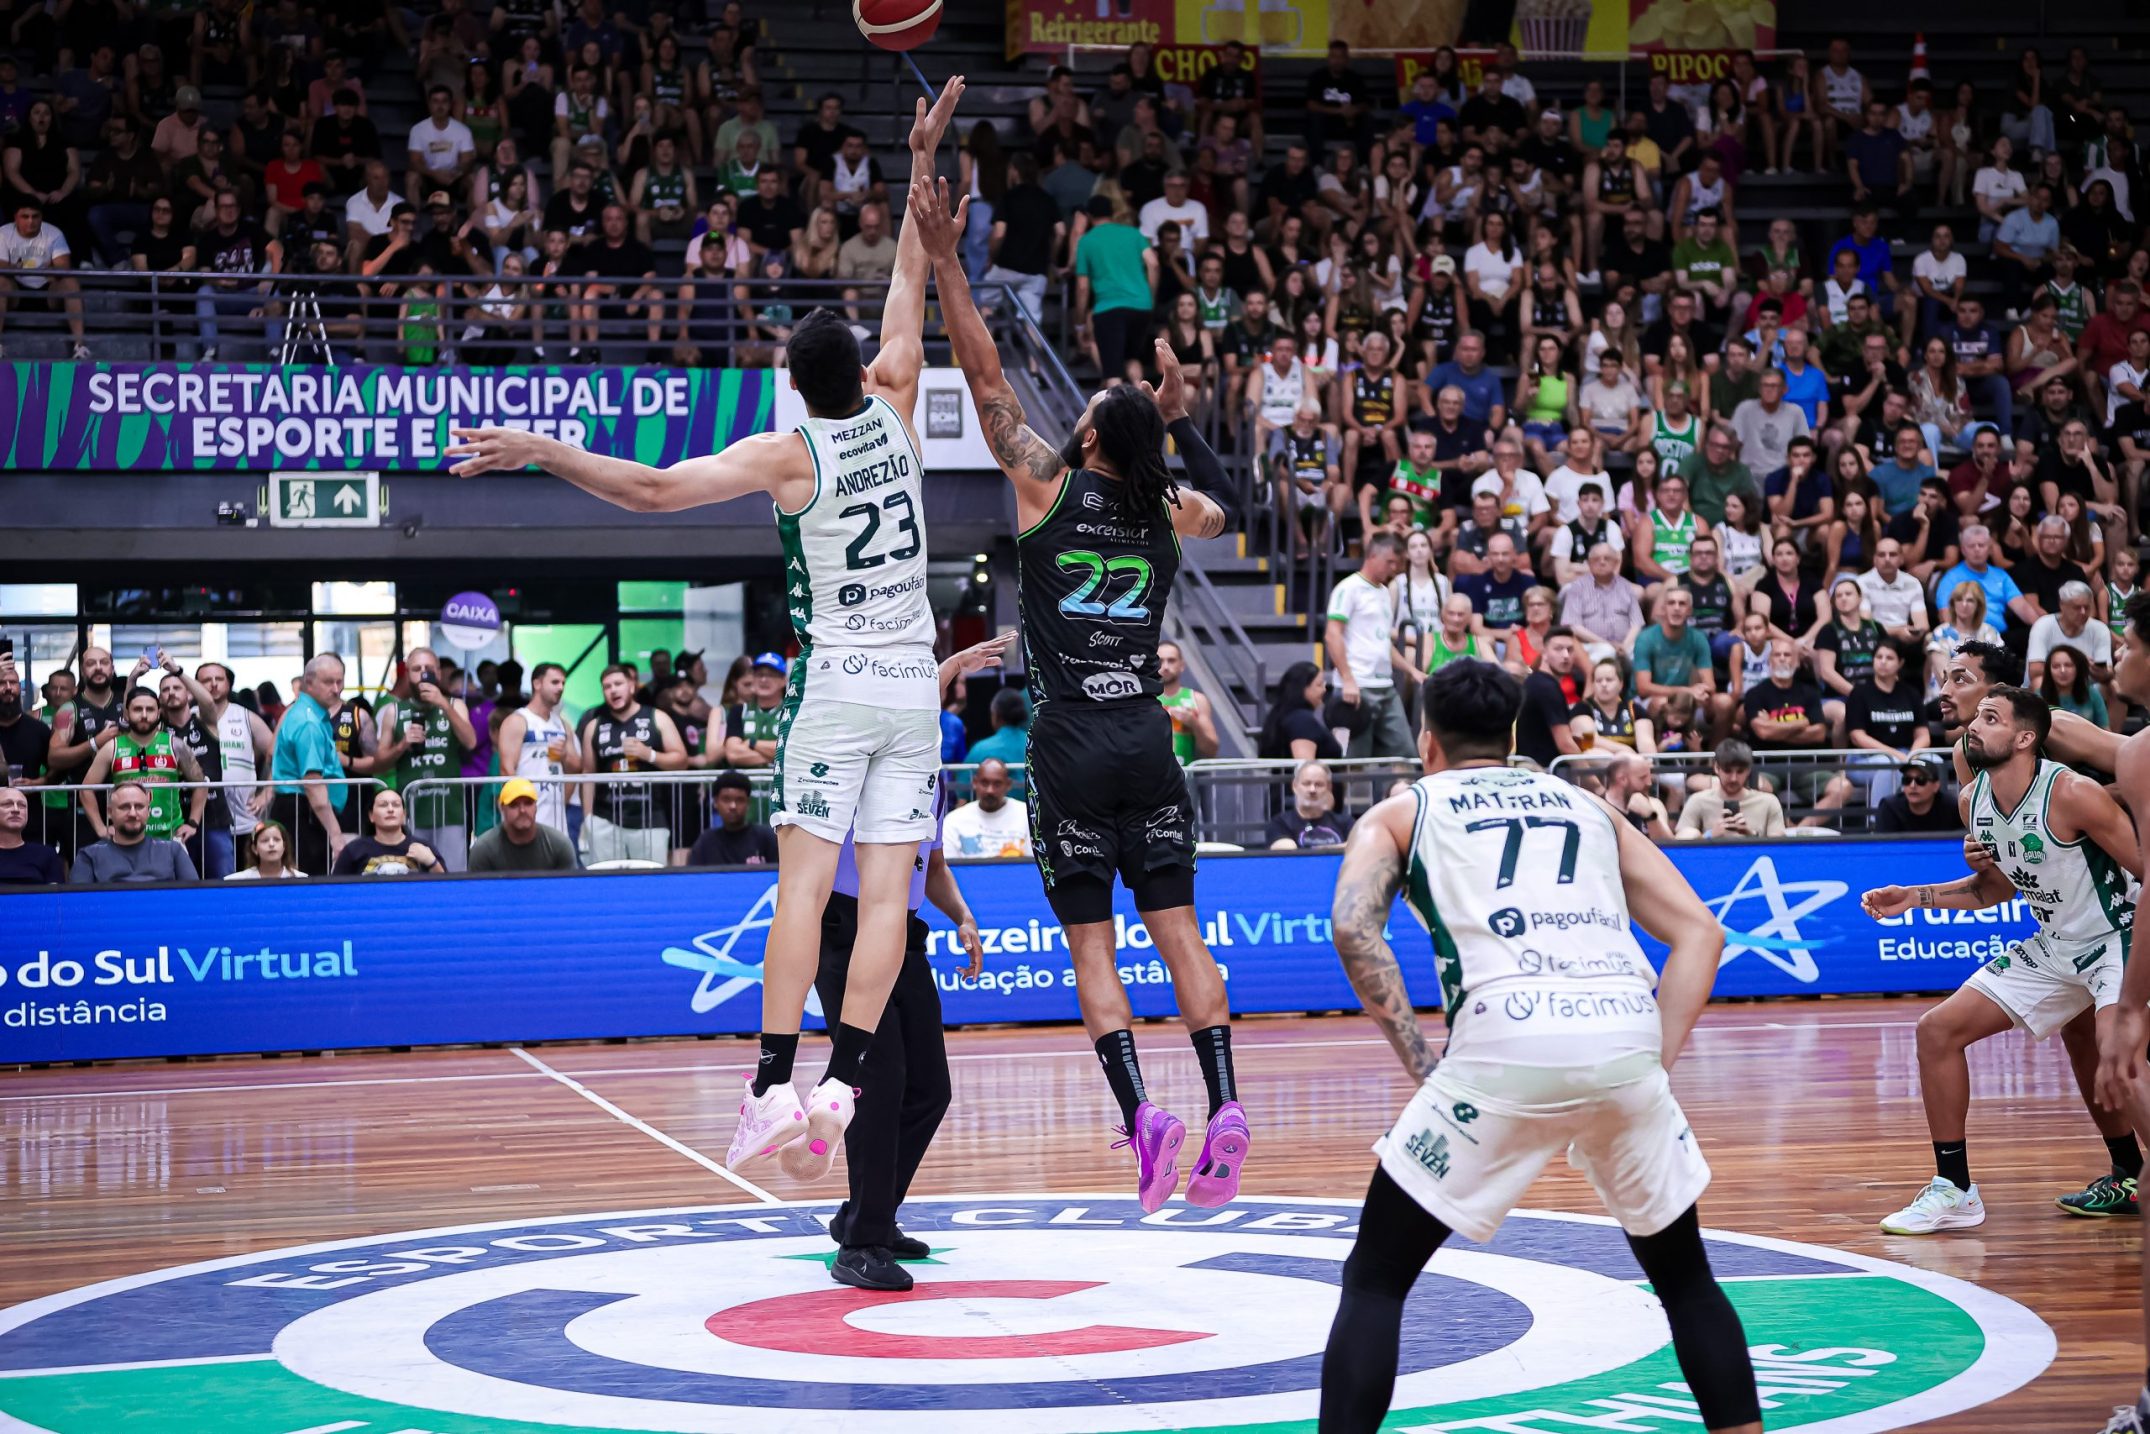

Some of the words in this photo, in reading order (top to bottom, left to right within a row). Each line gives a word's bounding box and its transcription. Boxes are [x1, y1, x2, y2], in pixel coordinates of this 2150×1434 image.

[1030, 11, 1161, 50] Refrigerante
[1154, 48, 1257, 82] CHO
[1652, 52, 1730, 80] PIPOC
[87, 373, 367, 414] SECRETARIA
[375, 376, 621, 416] MUNICIPAL
[632, 378, 690, 416] DE
[191, 416, 401, 458] ESPORTE
[418, 418, 437, 458] E
[449, 418, 587, 458] LER
[839, 441, 876, 460] ecovita
[835, 454, 909, 498] ANDREZÃO
[838, 489, 920, 571] 23
[1055, 549, 1155, 626] 22
[446, 602, 498, 623] CAIXA
[1087, 680, 1137, 695] MOR
[411, 753, 446, 768] KTO
[796, 801, 831, 819] SEVEN
[1465, 815, 1580, 890] 77
[1876, 898, 2029, 927] ruzeir
[2022, 888, 2064, 905] rmalat
[925, 918, 1070, 956] ruzeir
[17, 950, 85, 988] do
[94, 946, 174, 986] Sul
[177, 940, 358, 982] Virtual
[931, 964, 1054, 996] ucação
[4, 998, 167, 1027] distância
[1549, 992, 1654, 1018] facimus
[1405, 1134, 1451, 1179] SEVEN
[222, 1211, 904, 1291] ESPORT
[951, 1206, 1362, 1232] CLUB
